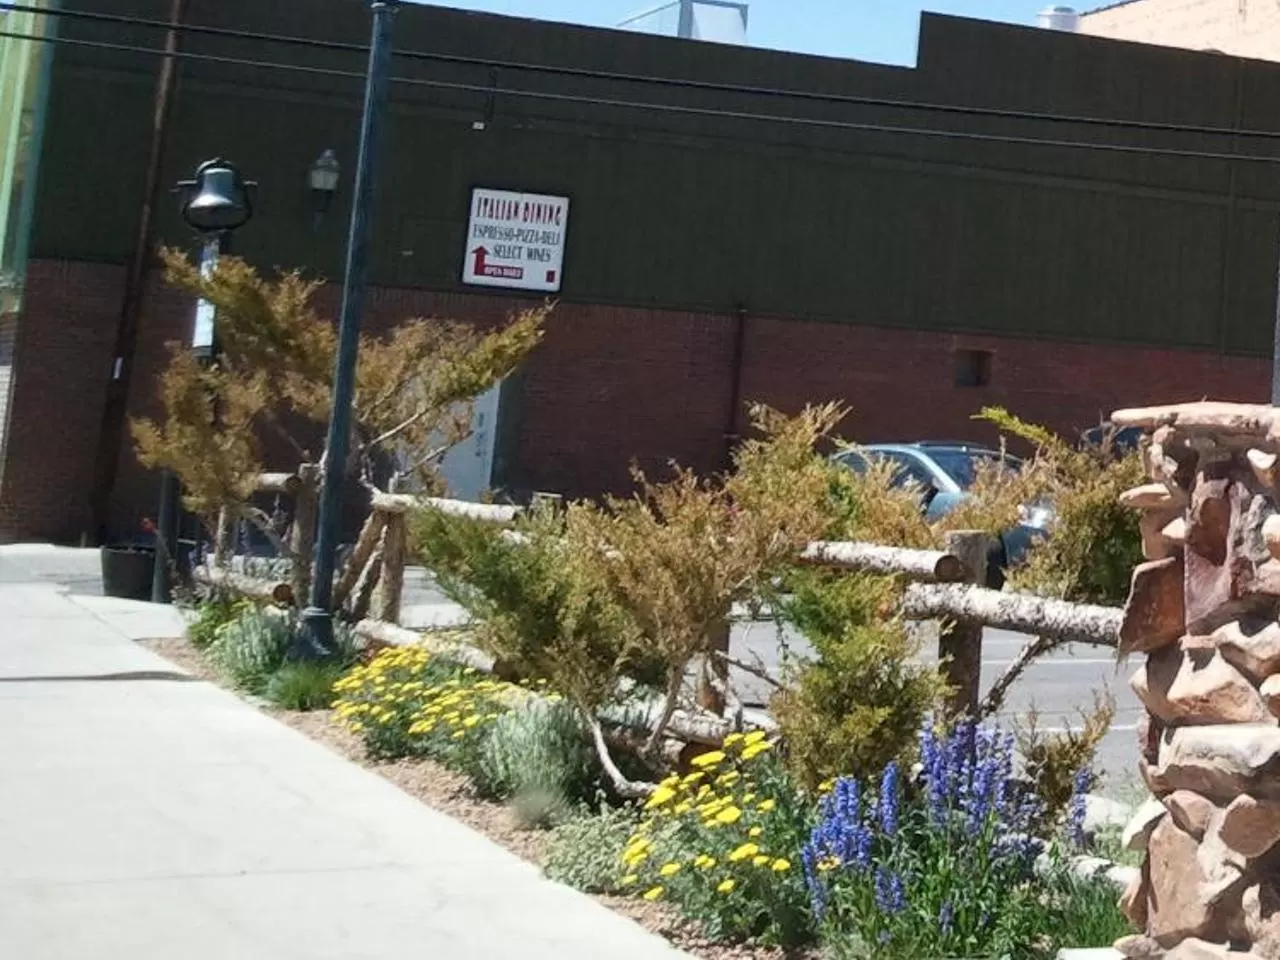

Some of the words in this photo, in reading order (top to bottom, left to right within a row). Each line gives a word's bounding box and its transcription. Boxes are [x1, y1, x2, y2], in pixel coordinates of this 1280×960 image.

[477, 196, 520, 221] ITALIAN
[523, 201, 562, 226] DINING
[493, 244, 523, 259] SELECT
[527, 246, 552, 262] WINES
